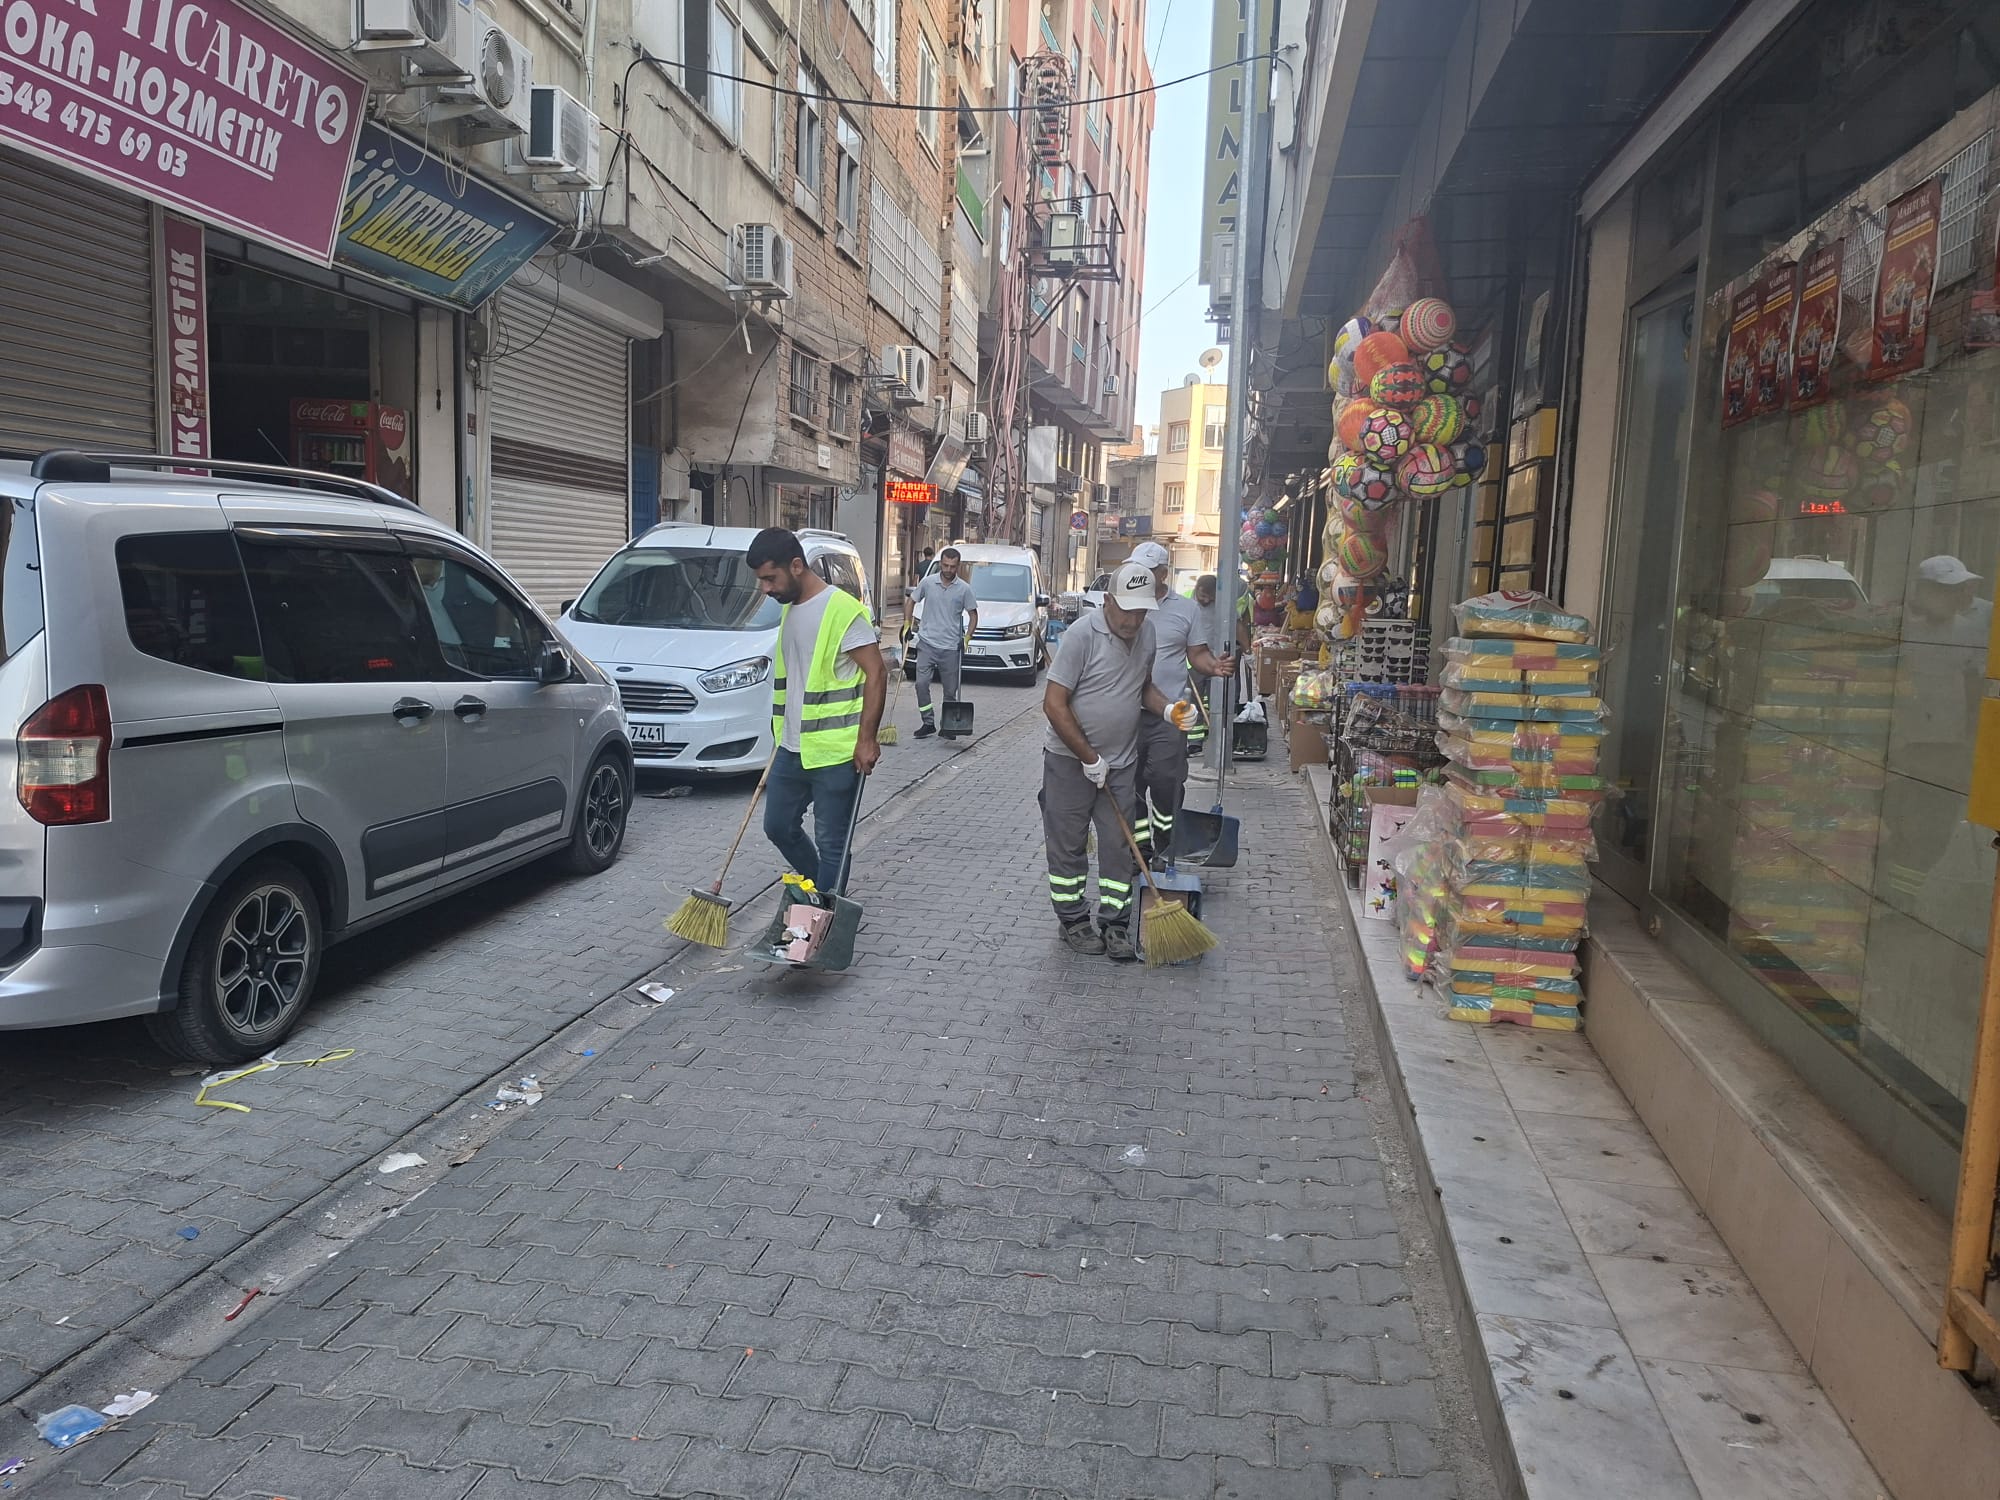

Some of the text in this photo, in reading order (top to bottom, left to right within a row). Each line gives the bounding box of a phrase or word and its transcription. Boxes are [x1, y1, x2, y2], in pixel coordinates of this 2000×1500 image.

[59, 101, 112, 146] 475
[119, 126, 152, 162] 69
[157, 142, 188, 177] 03
[1129, 575, 1148, 585] NIKE
[630, 726, 661, 741] 7441
